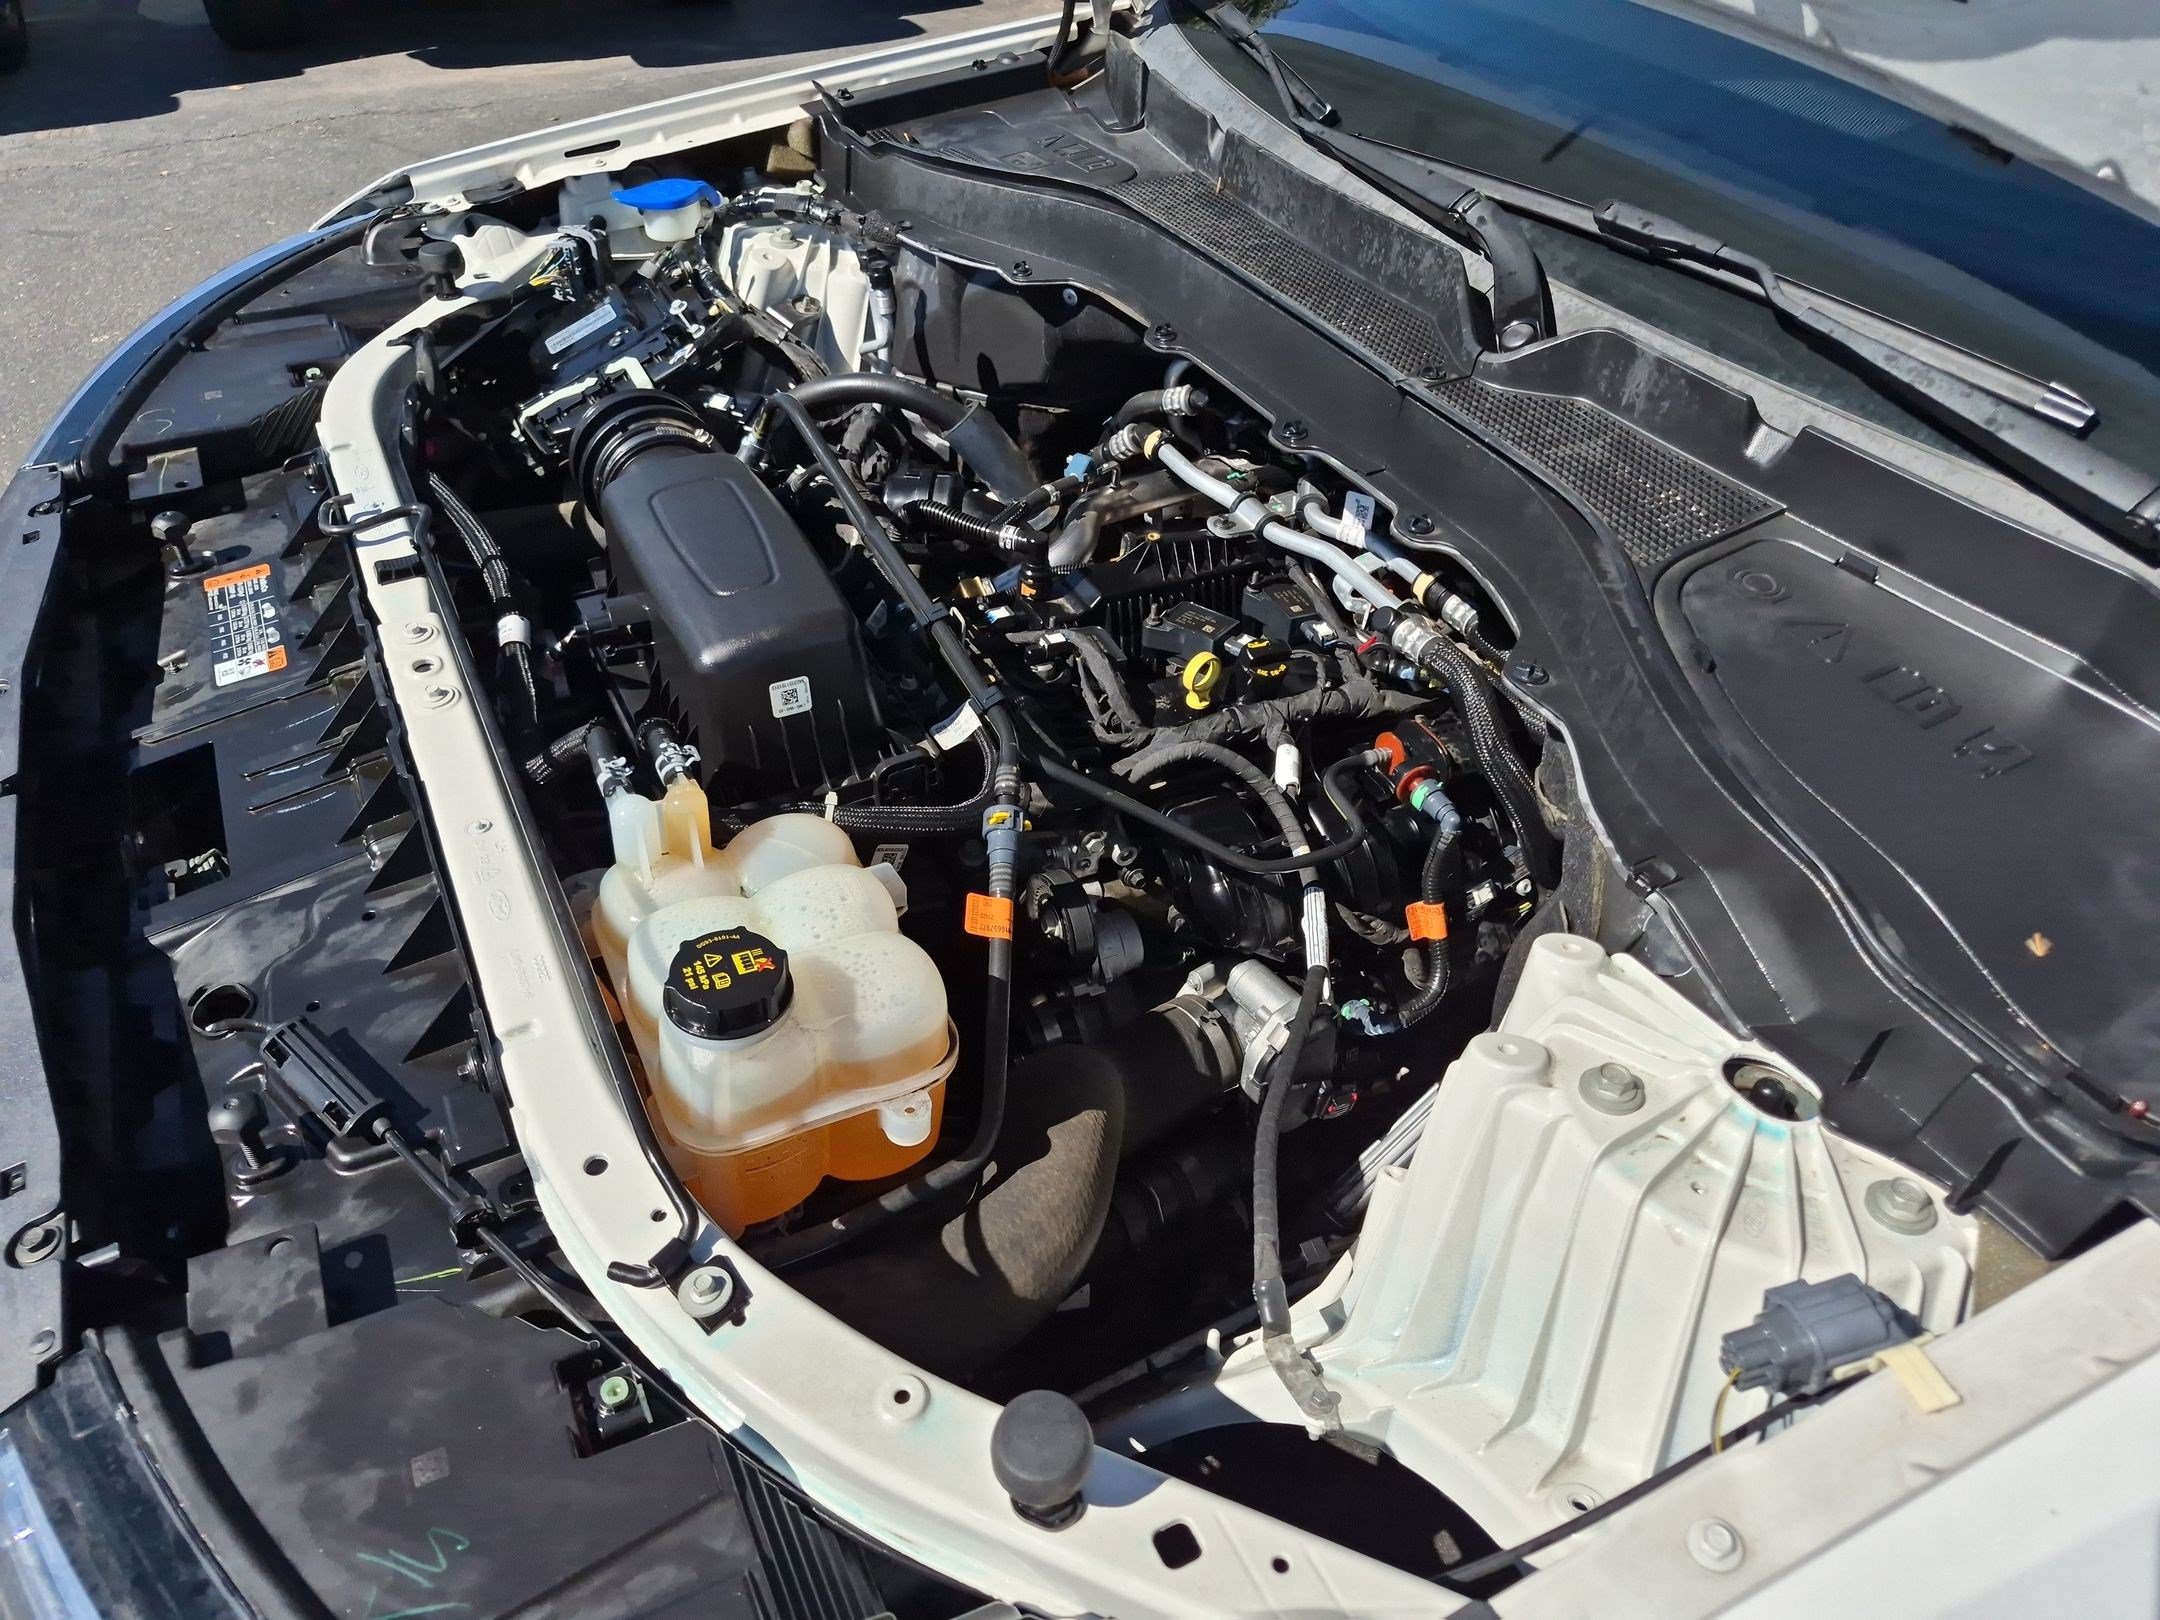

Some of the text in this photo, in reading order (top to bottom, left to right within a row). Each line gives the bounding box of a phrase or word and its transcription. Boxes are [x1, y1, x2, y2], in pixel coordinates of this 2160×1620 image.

[683, 967, 698, 990] 21 psi
[693, 960, 709, 990] 145 kPa
